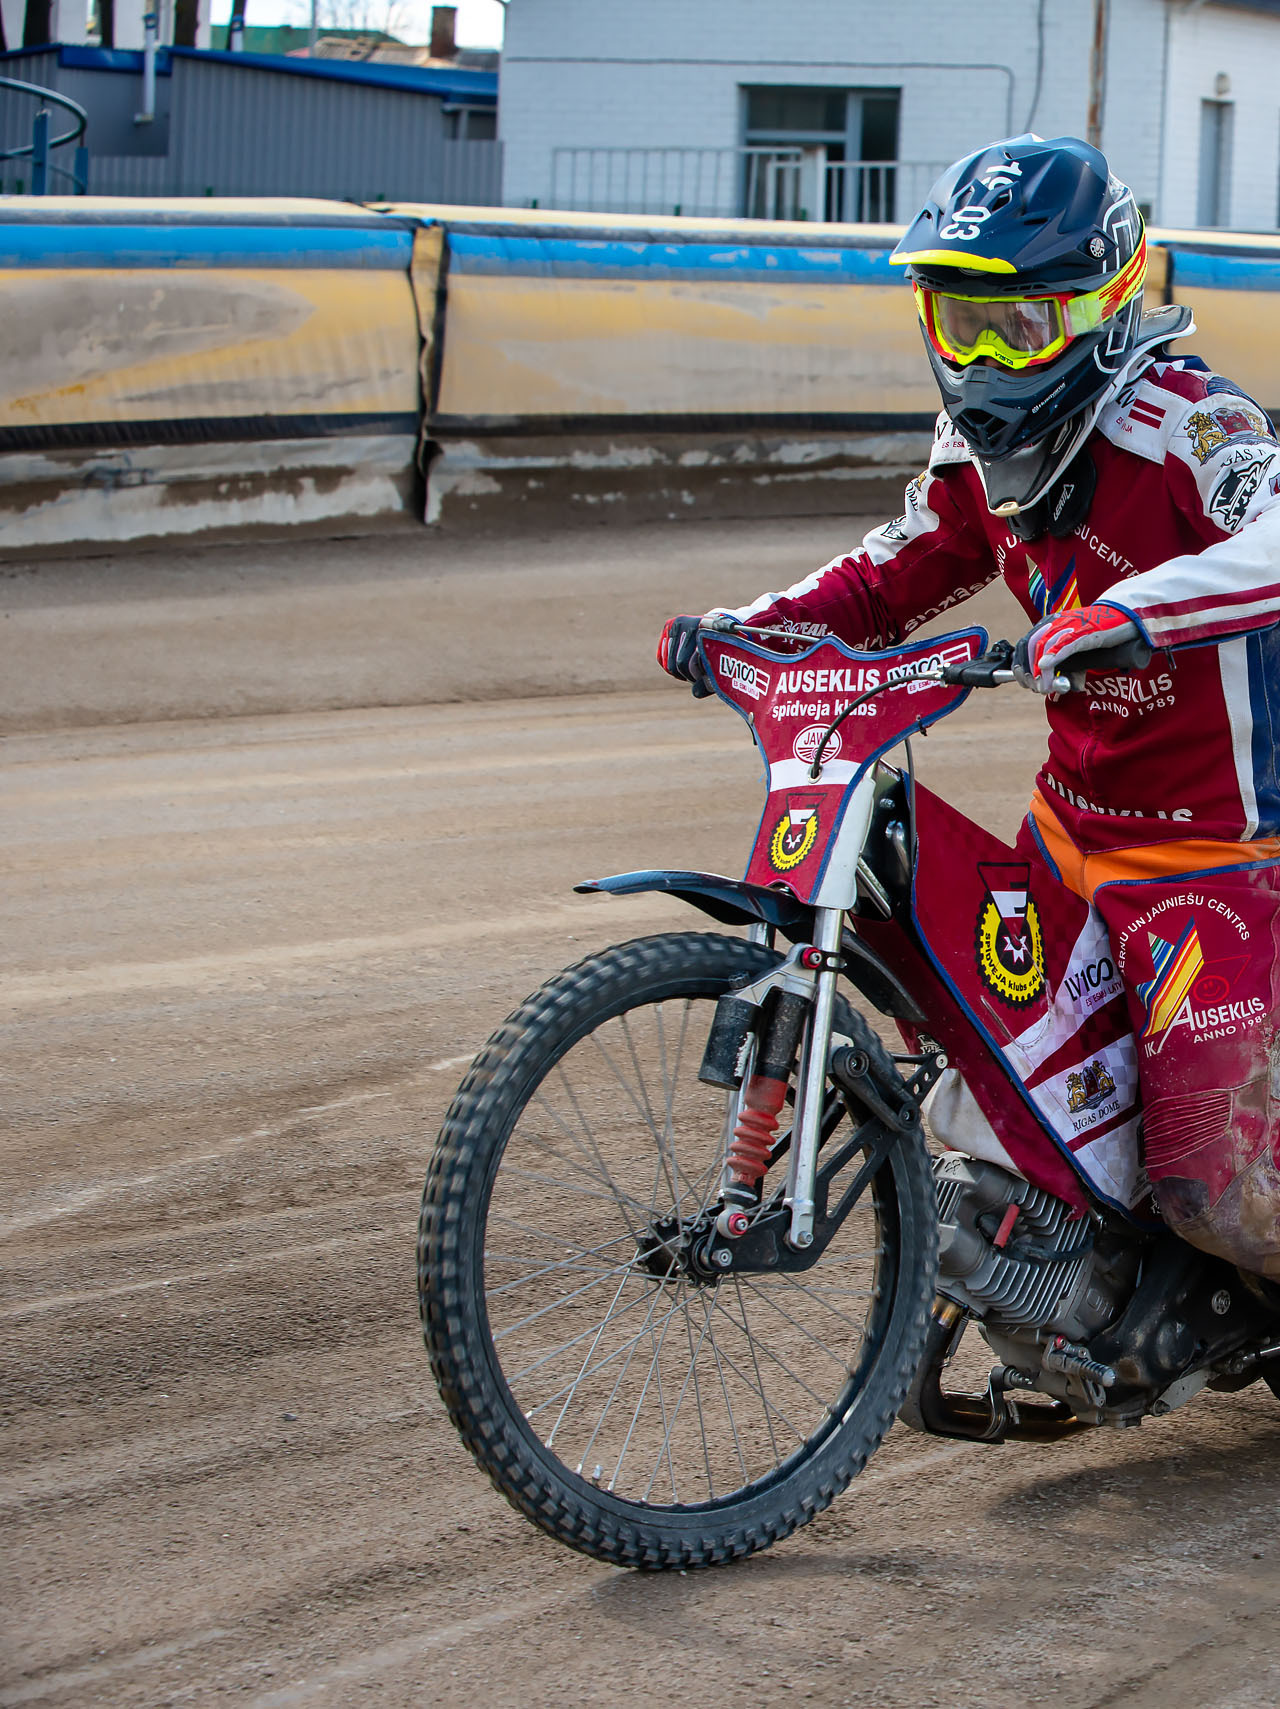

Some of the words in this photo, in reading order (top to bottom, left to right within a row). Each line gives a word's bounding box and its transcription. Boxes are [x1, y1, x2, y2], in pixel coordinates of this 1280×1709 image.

[775, 668, 880, 695] AUSEKLIS
[1084, 672, 1173, 703] USEKLIS
[772, 700, 831, 720] spīdveja
[1089, 700, 1129, 718] ANNO
[1138, 695, 1175, 716] 1989
[1127, 917, 1146, 933] UN
[1145, 892, 1205, 923] JAUNIEŠU
[1207, 898, 1250, 941] CENTRS
[1008, 980, 1027, 992] klubs
[1107, 981, 1123, 995] LATV
[1156, 995, 1265, 1055] AUSEKLIS
[1193, 1025, 1237, 1044] ANNO
[1098, 1099, 1121, 1119] DOME
